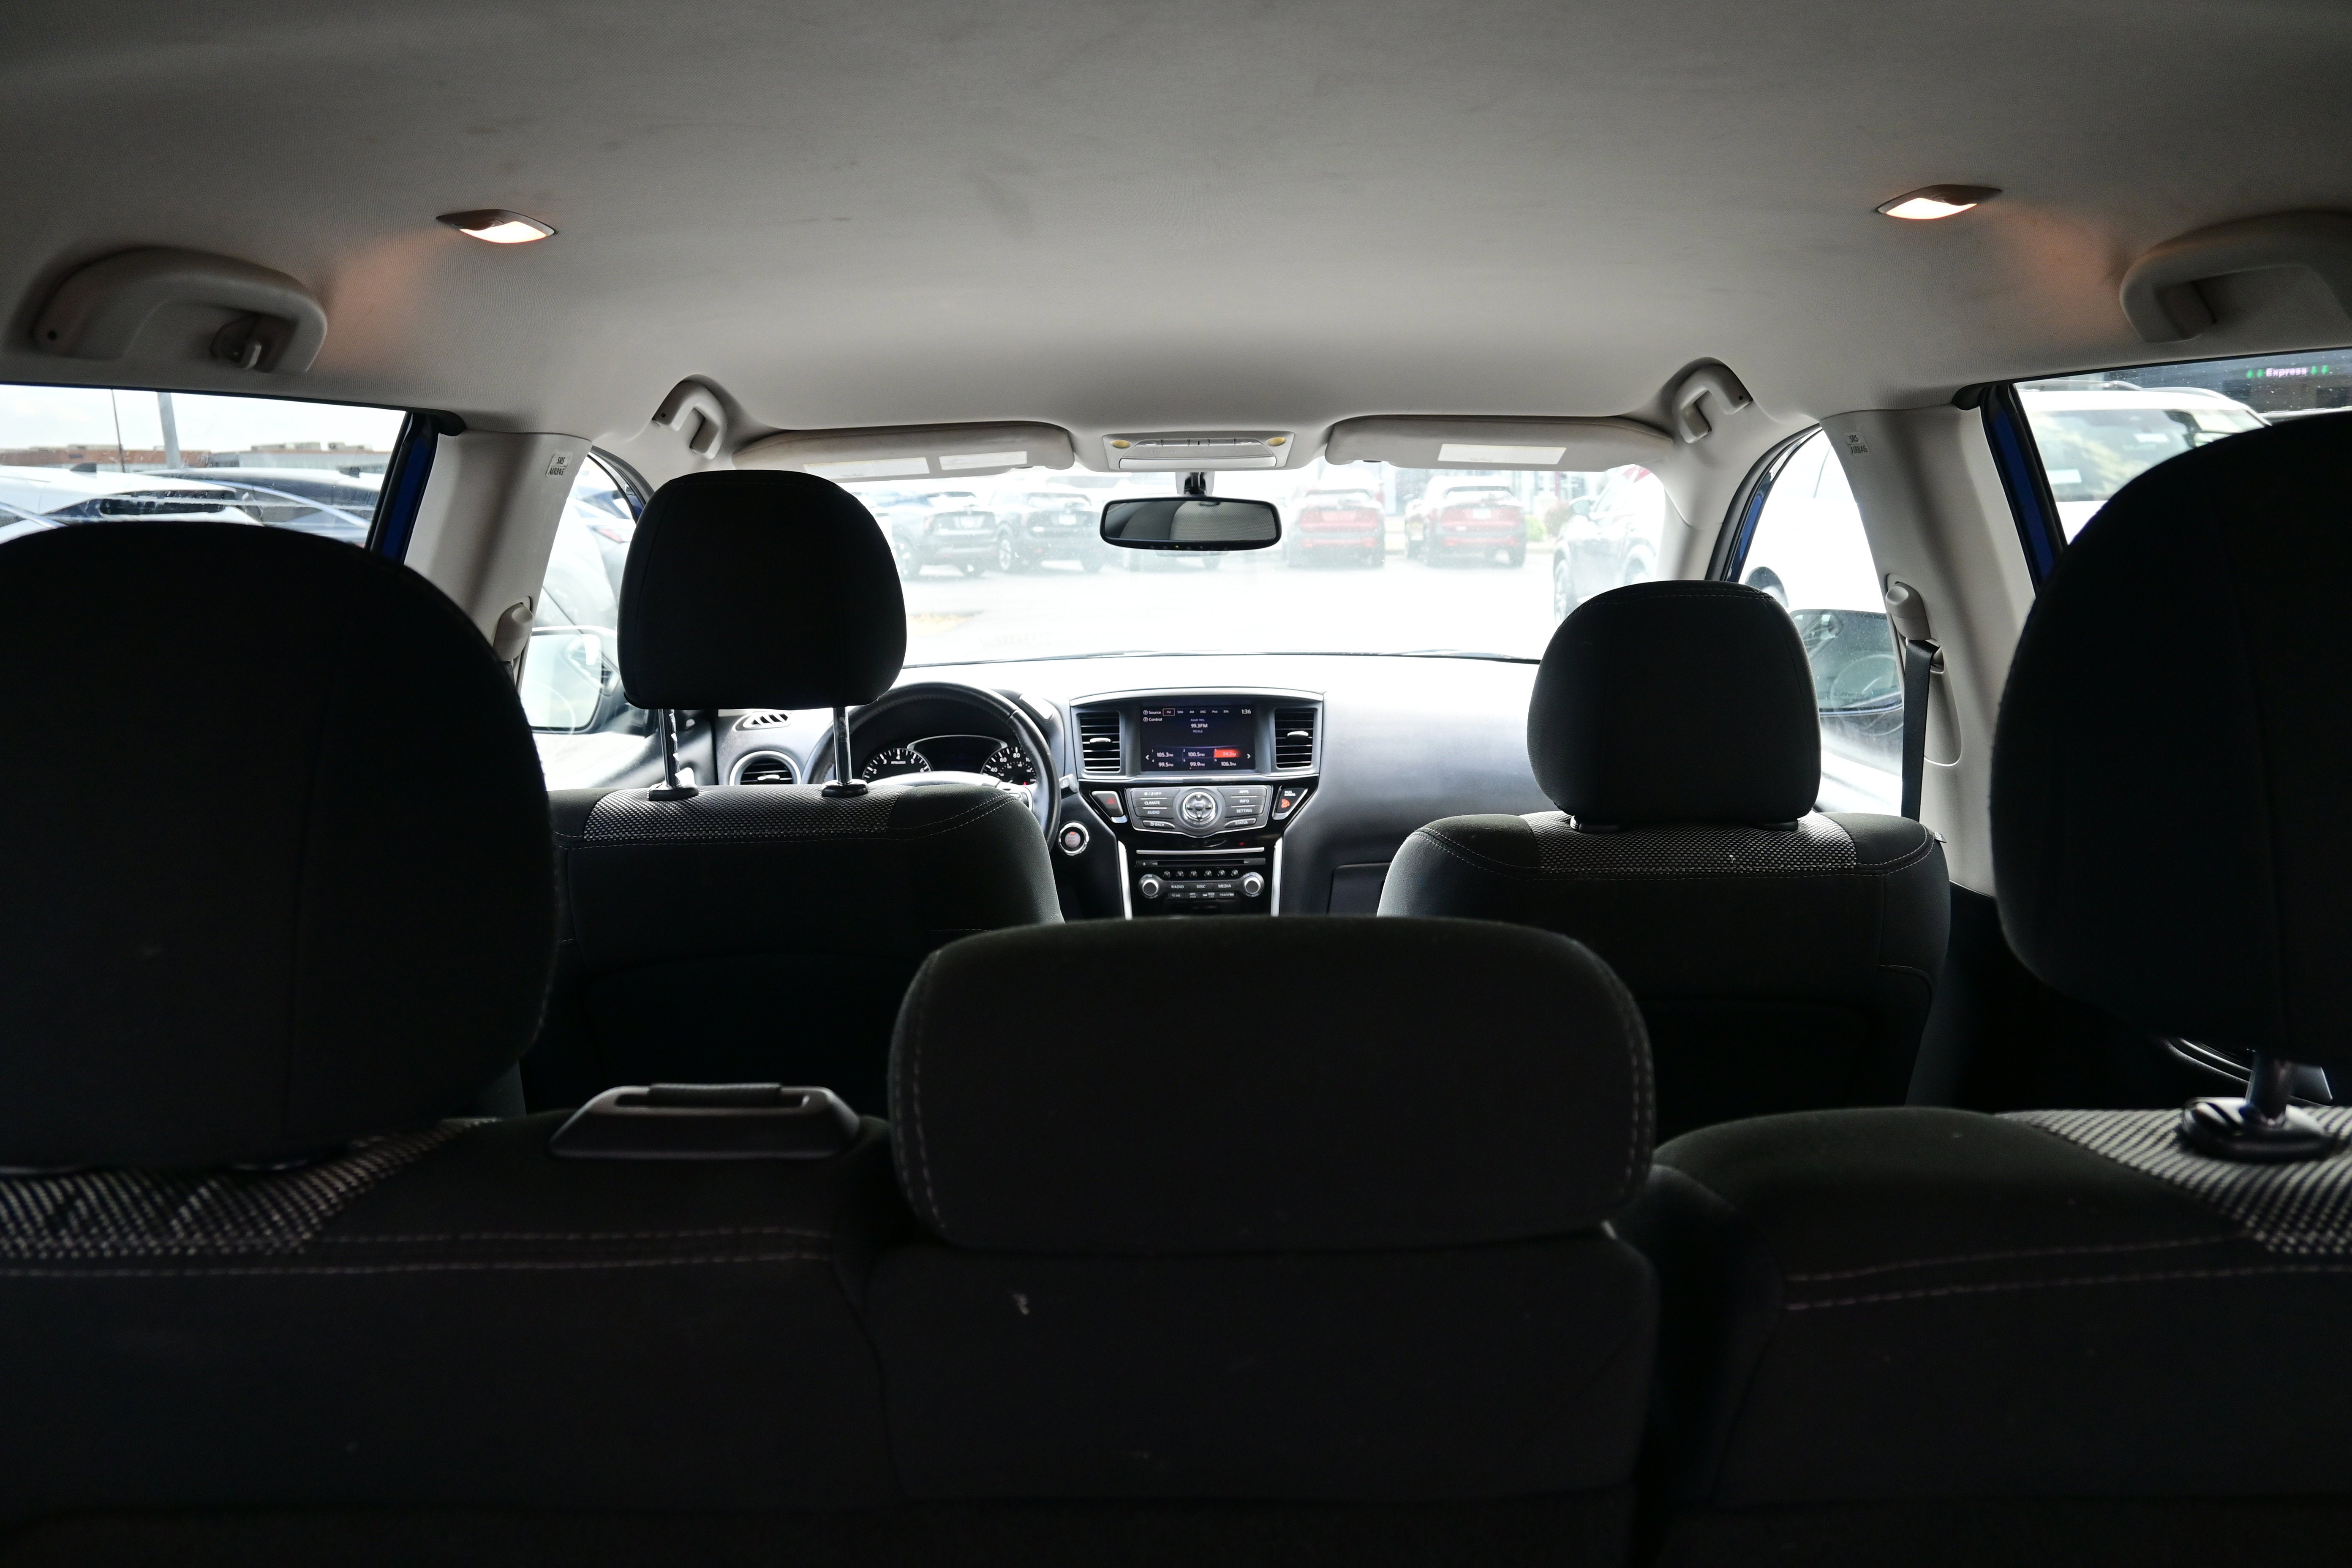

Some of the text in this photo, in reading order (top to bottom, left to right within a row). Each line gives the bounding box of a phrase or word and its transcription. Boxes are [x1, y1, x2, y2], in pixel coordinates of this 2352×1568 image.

[2266, 367, 2307, 378] Express
[1851, 445, 1868, 454] AIRBAG
[556, 456, 566, 464] SRS
[548, 467, 565, 476] AIRBAG
